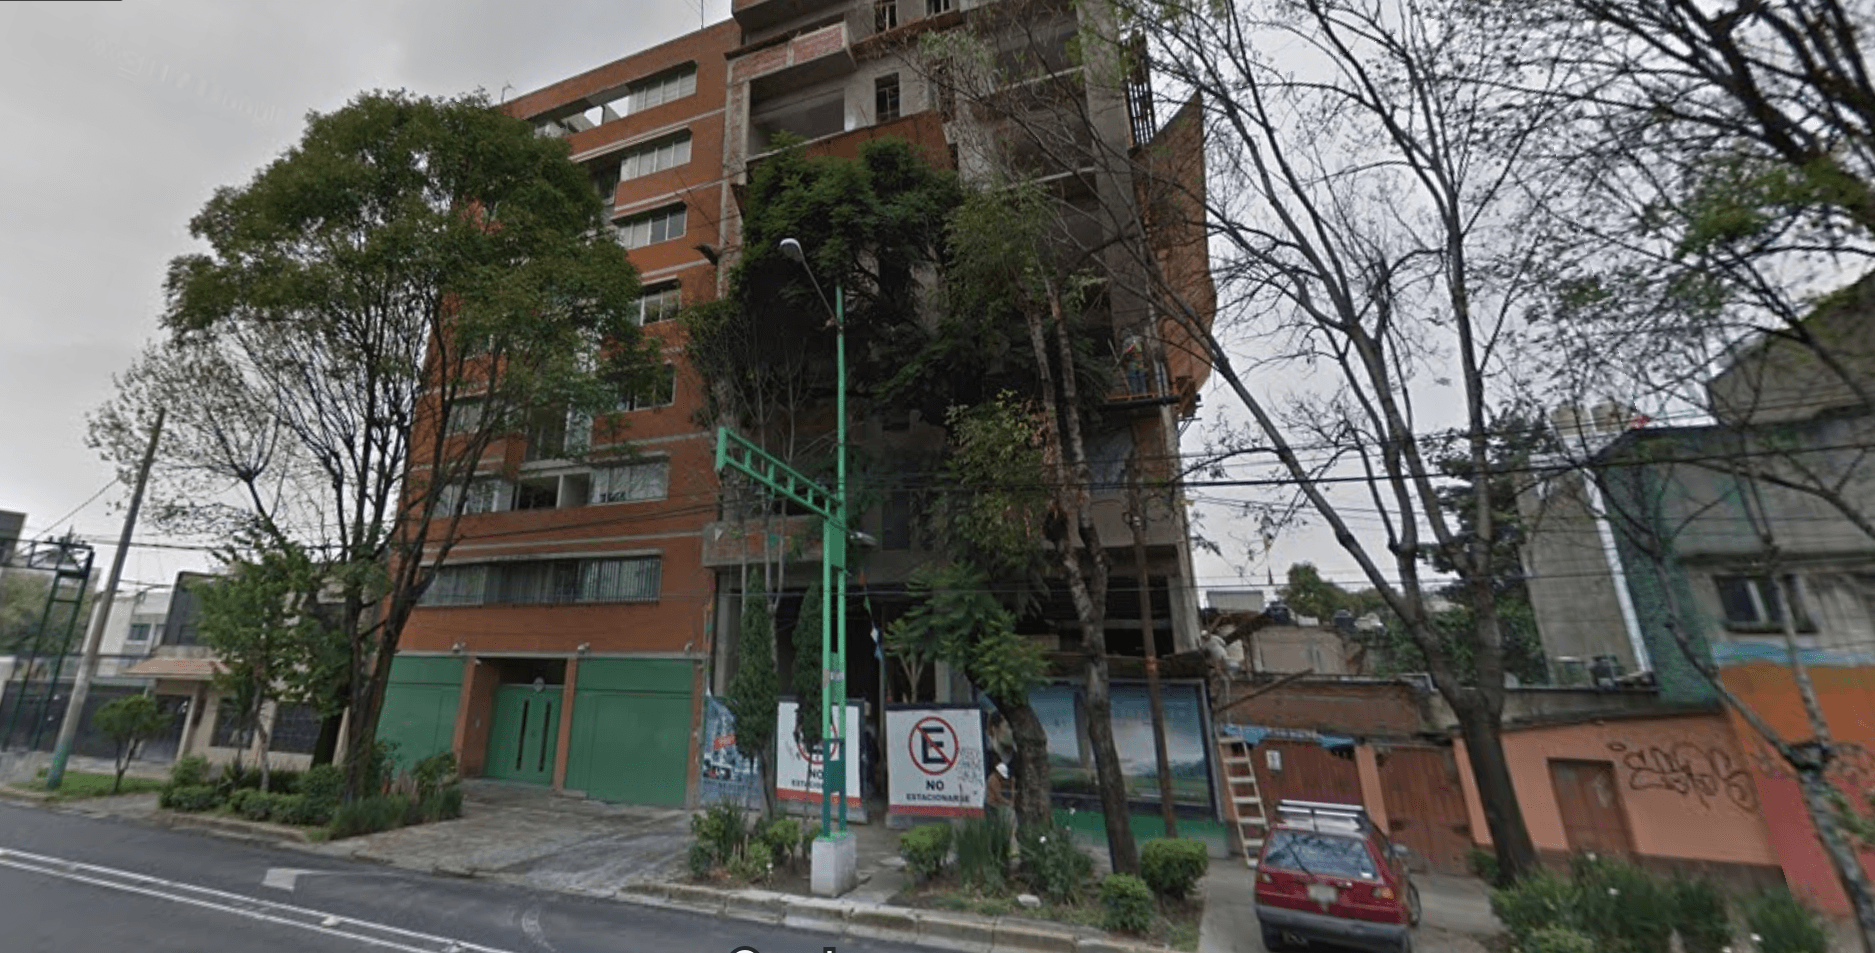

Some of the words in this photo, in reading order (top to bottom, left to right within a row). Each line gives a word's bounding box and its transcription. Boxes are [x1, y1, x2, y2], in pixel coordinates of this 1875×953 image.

[921, 726, 947, 764] E
[925, 780, 945, 791] NO
[906, 793, 969, 802] ESTACIONARSE
